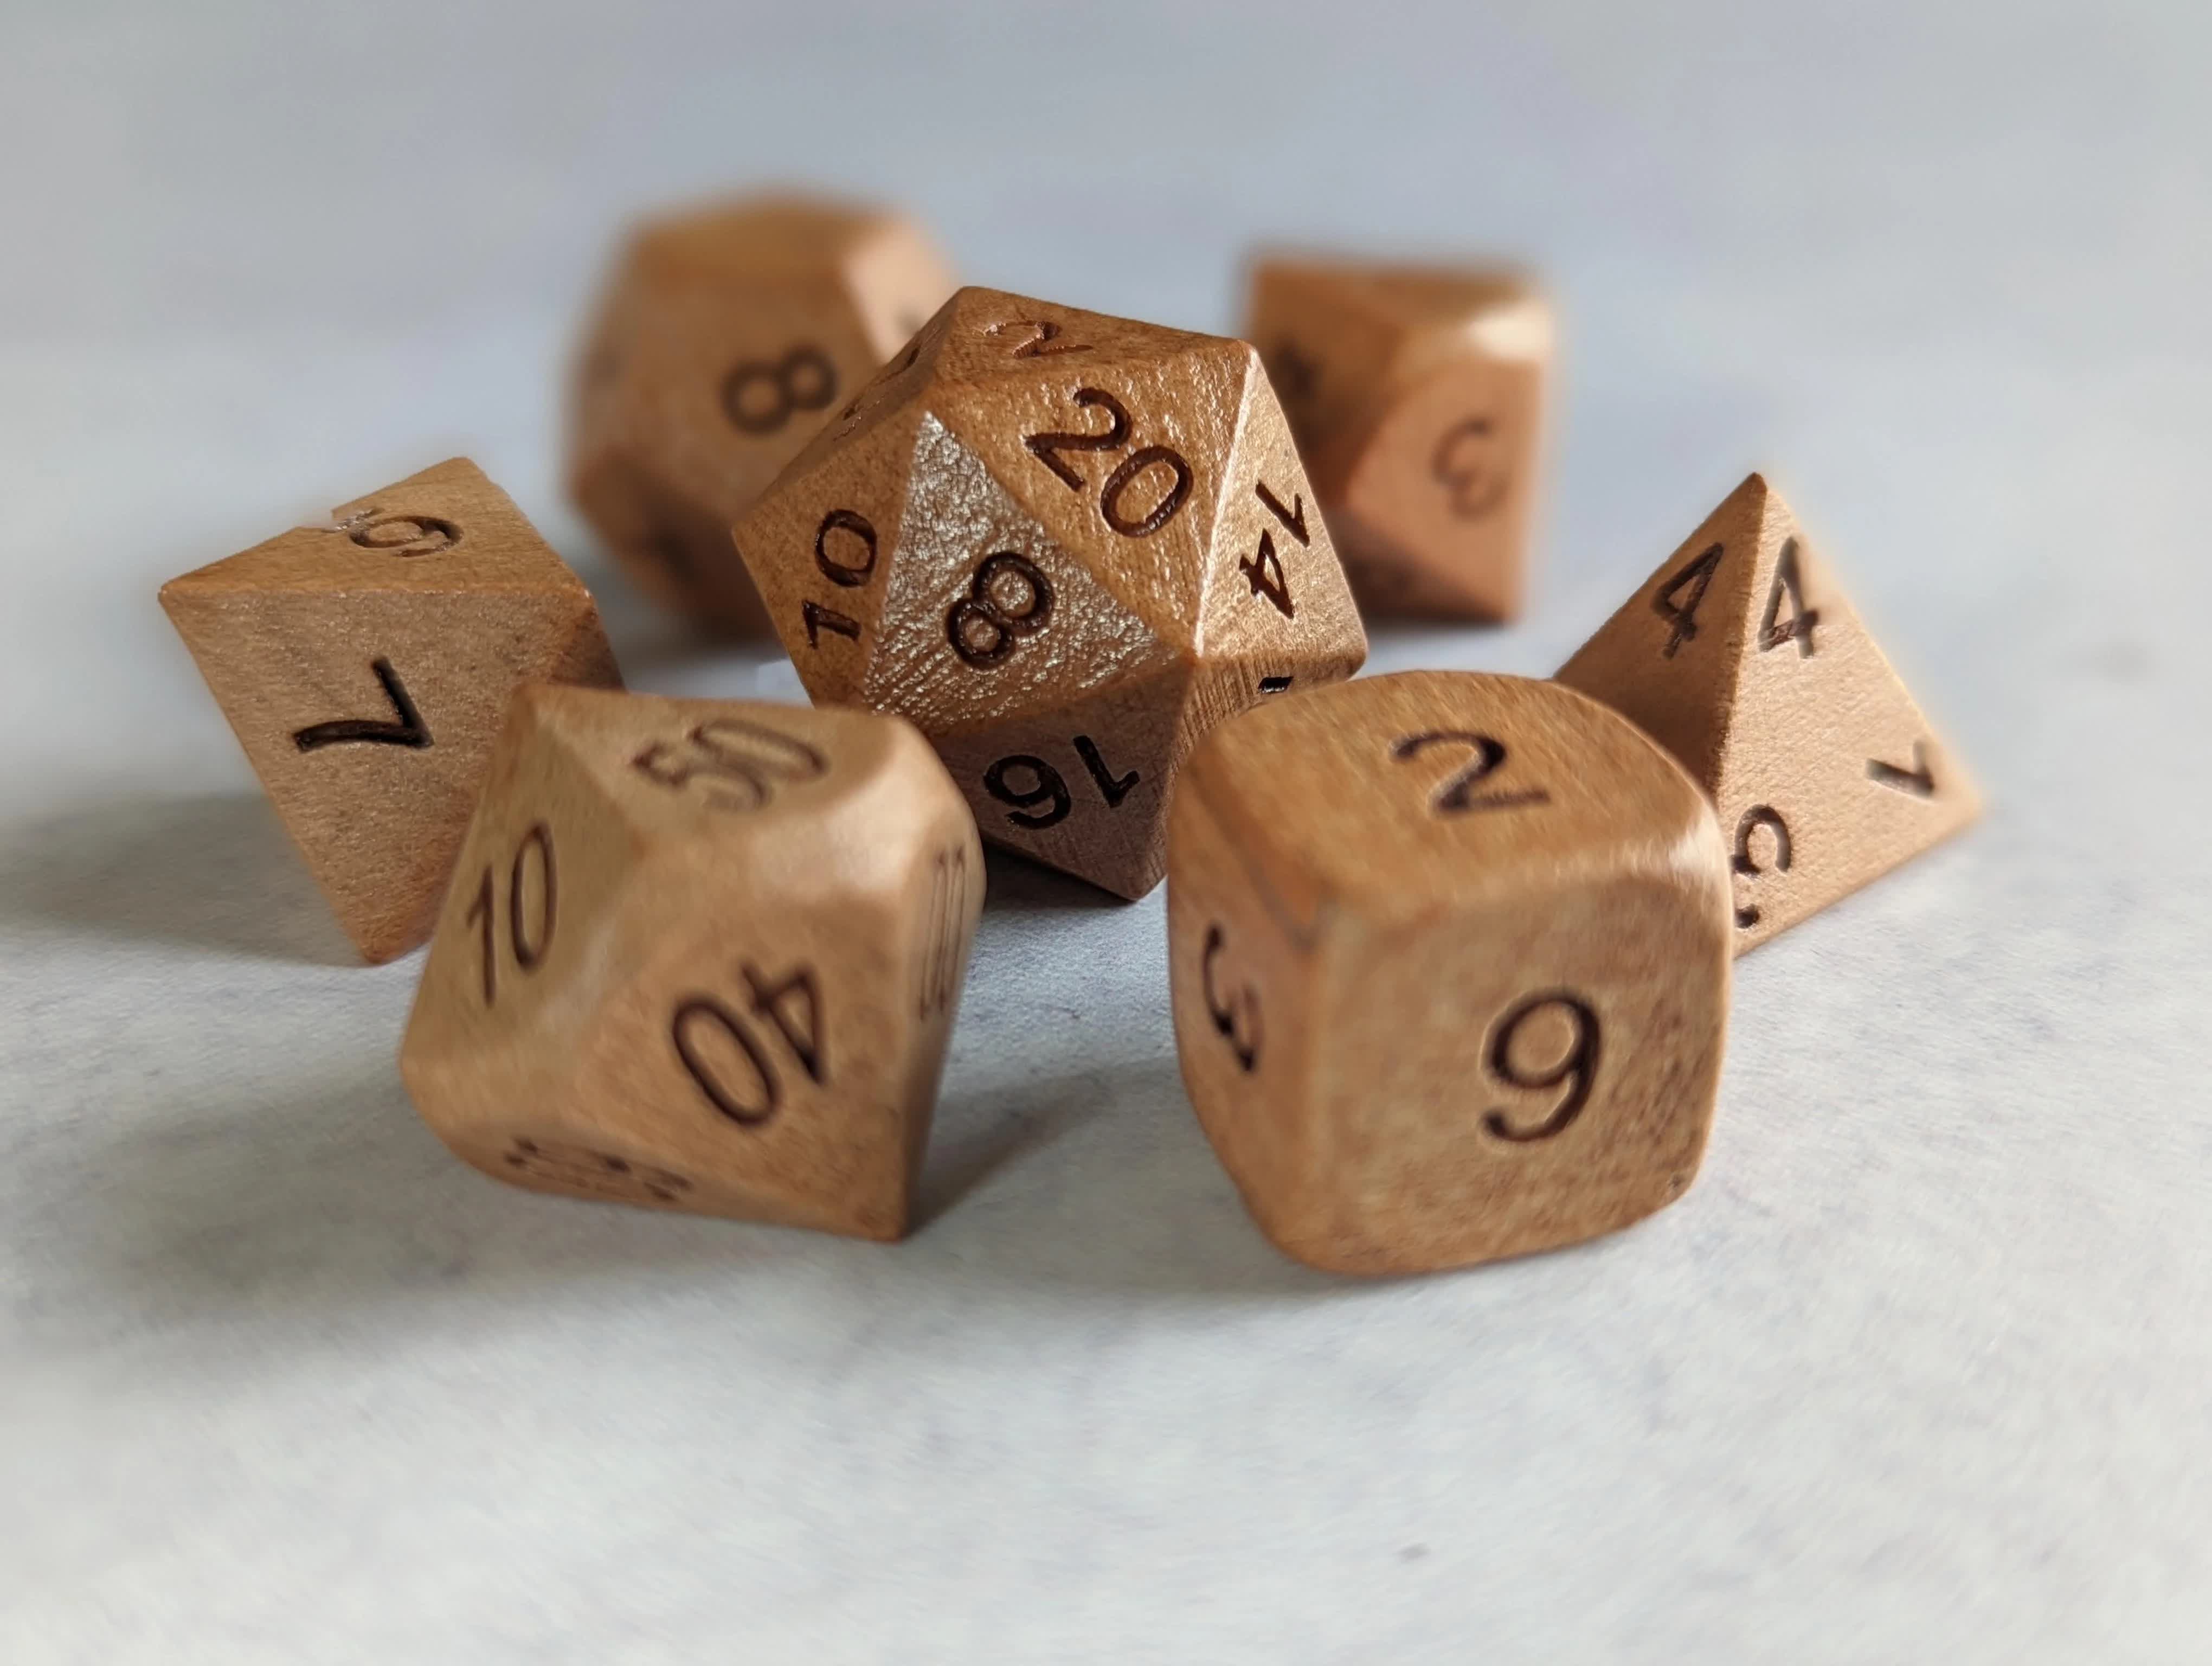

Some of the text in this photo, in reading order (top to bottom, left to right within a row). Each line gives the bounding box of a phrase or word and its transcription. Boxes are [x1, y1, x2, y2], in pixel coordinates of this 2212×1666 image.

[719, 344, 839, 438] 8
[1024, 386, 1193, 538] 20
[802, 508, 878, 651] 10
[1238, 480, 1311, 619] 14
[1651, 542, 1724, 659] 4
[1758, 535, 1821, 659] 4
[946, 551, 1054, 670] 8
[292, 656, 434, 751] 7
[629, 716, 832, 815] 50
[982, 734, 1140, 830] 16
[1388, 729, 1552, 817] 2
[464, 817, 560, 1011] 10
[671, 959, 828, 1130] 40
